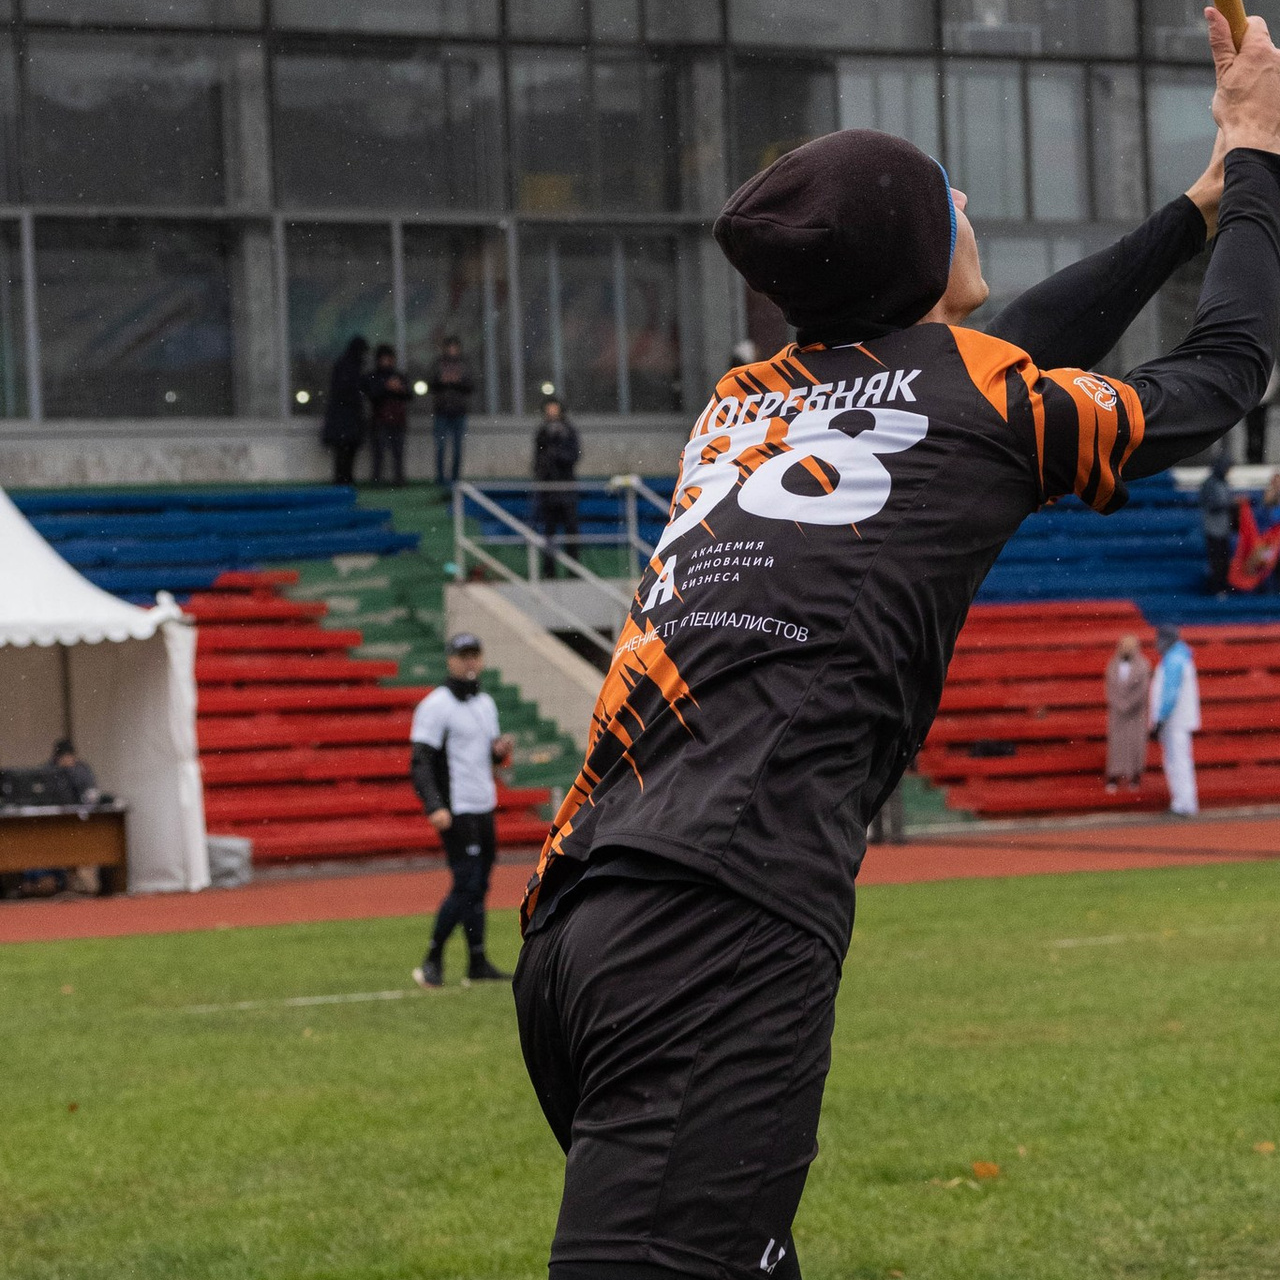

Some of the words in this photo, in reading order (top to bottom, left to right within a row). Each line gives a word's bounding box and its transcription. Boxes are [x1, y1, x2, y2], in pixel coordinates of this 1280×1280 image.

[691, 541, 765, 559] АКАДЕМИЯ
[687, 555, 775, 576] ИННОВАЦИЙ
[681, 572, 740, 591] БИЗНЕСА
[663, 619, 678, 638] IT
